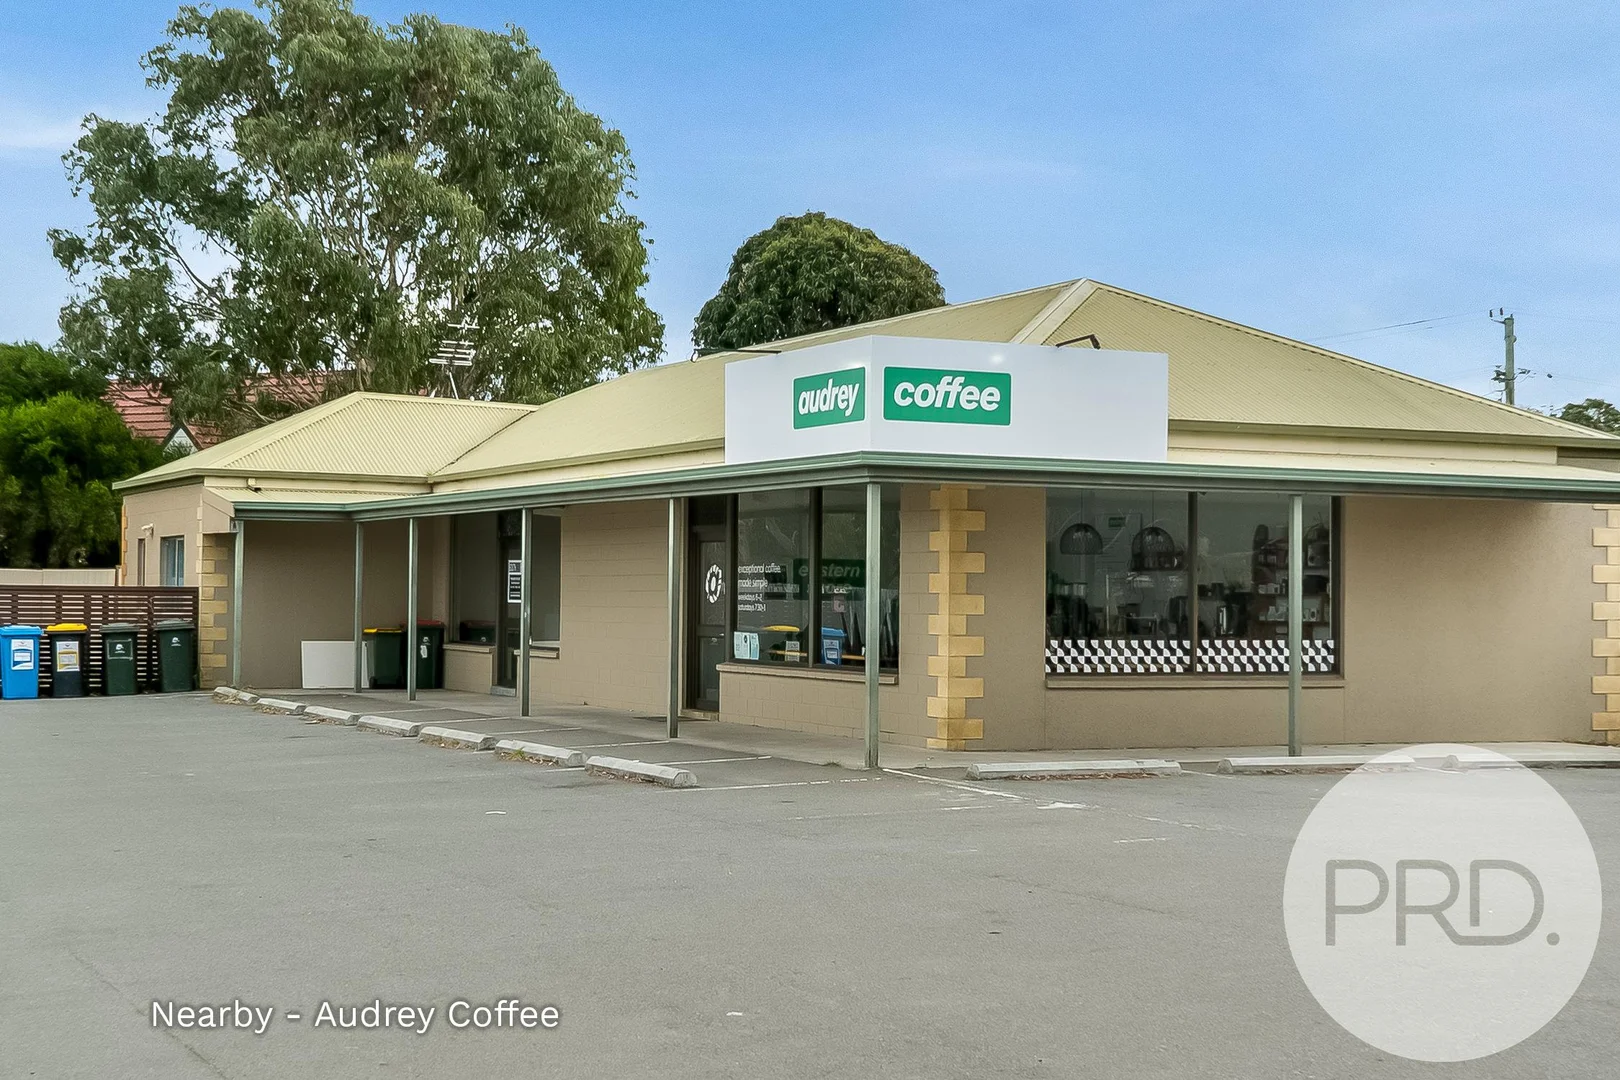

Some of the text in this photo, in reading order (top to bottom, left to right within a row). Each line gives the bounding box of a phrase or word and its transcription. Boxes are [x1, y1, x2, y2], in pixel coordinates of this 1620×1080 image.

[799, 379, 860, 417] audrey
[894, 376, 1001, 411] coffee
[738, 563, 765, 575] exceptional
[799, 563, 861, 578] estern
[752, 577, 768, 590] simple
